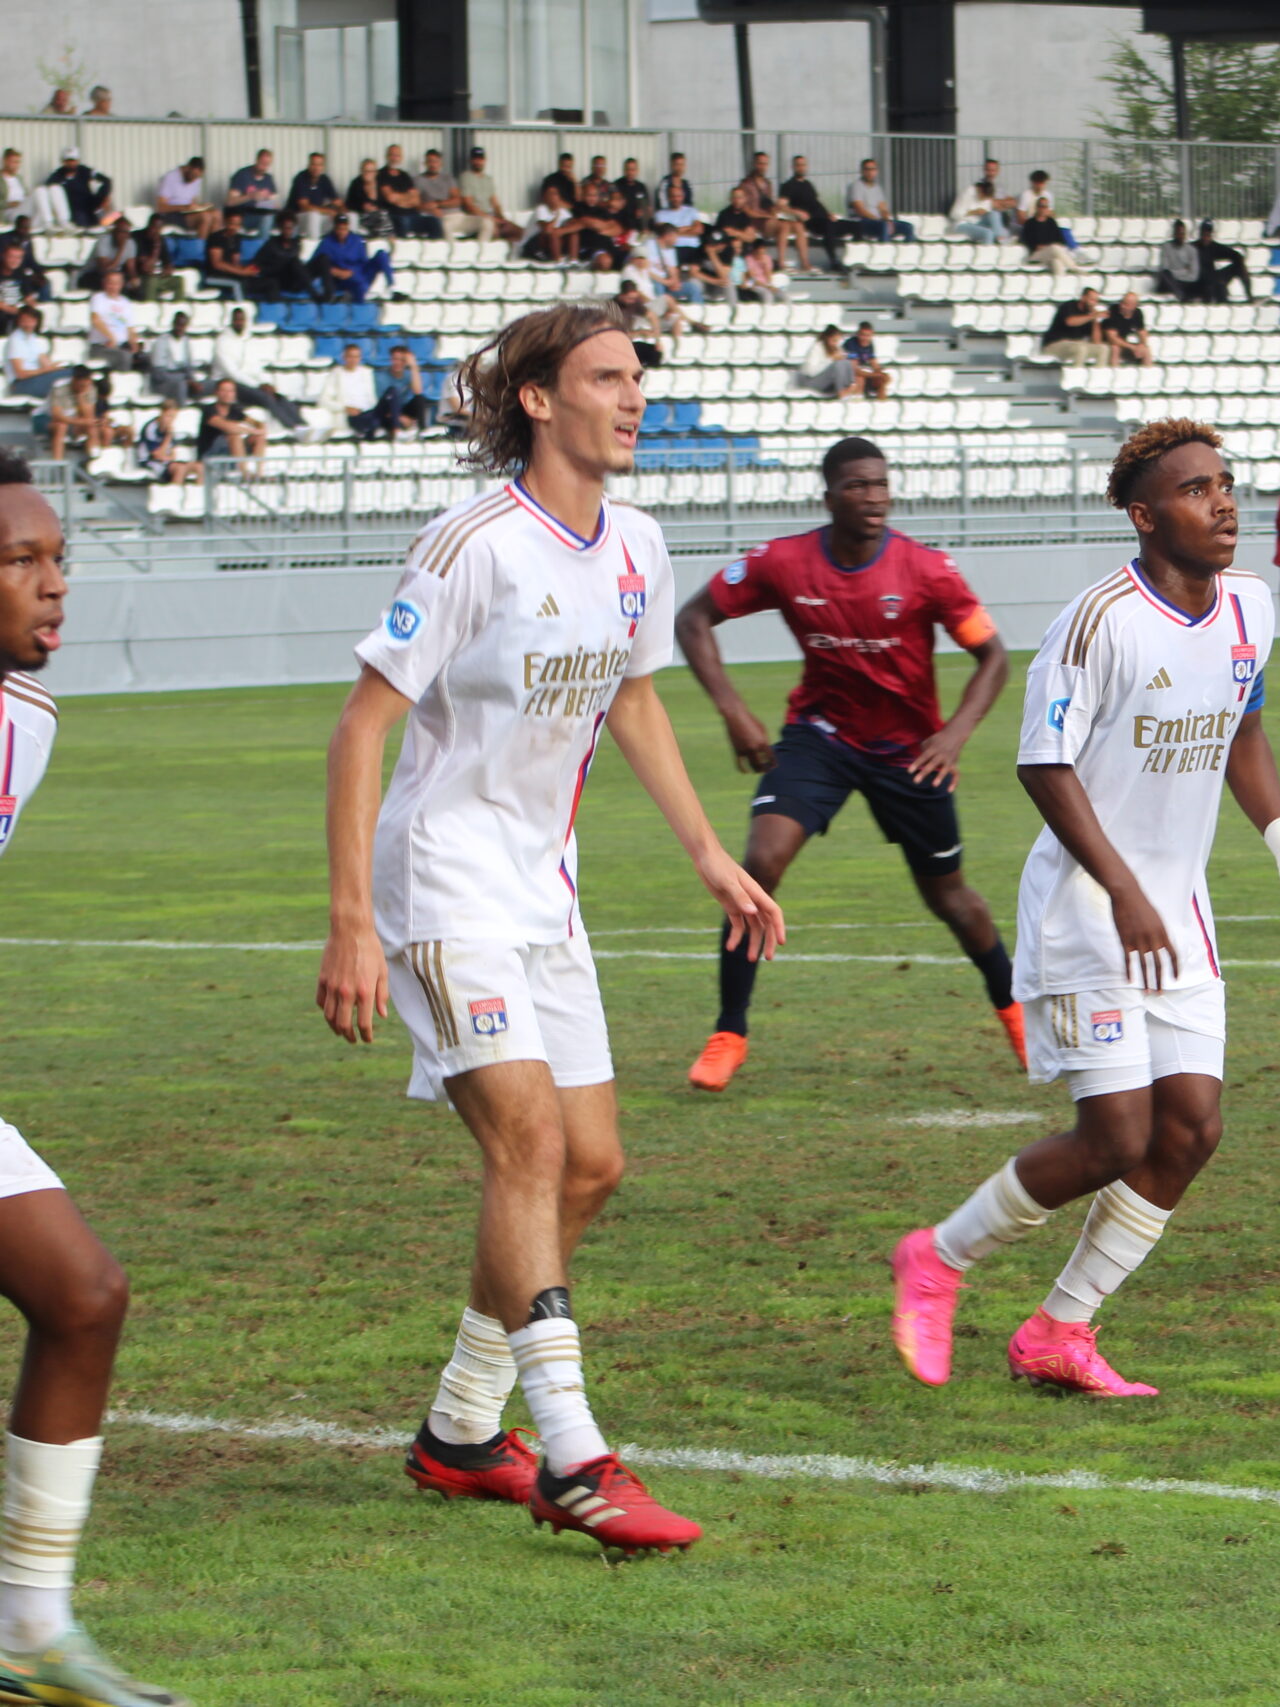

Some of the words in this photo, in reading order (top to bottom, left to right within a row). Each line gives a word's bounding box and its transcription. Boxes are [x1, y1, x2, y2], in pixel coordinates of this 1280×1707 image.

[622, 593, 644, 616] OL
[392, 605, 416, 633] N3
[1234, 660, 1254, 680] OL
[524, 685, 563, 717] FLY
[1141, 747, 1177, 774] FLY
[475, 1013, 506, 1033] OL
[1094, 1022, 1122, 1041] OL
